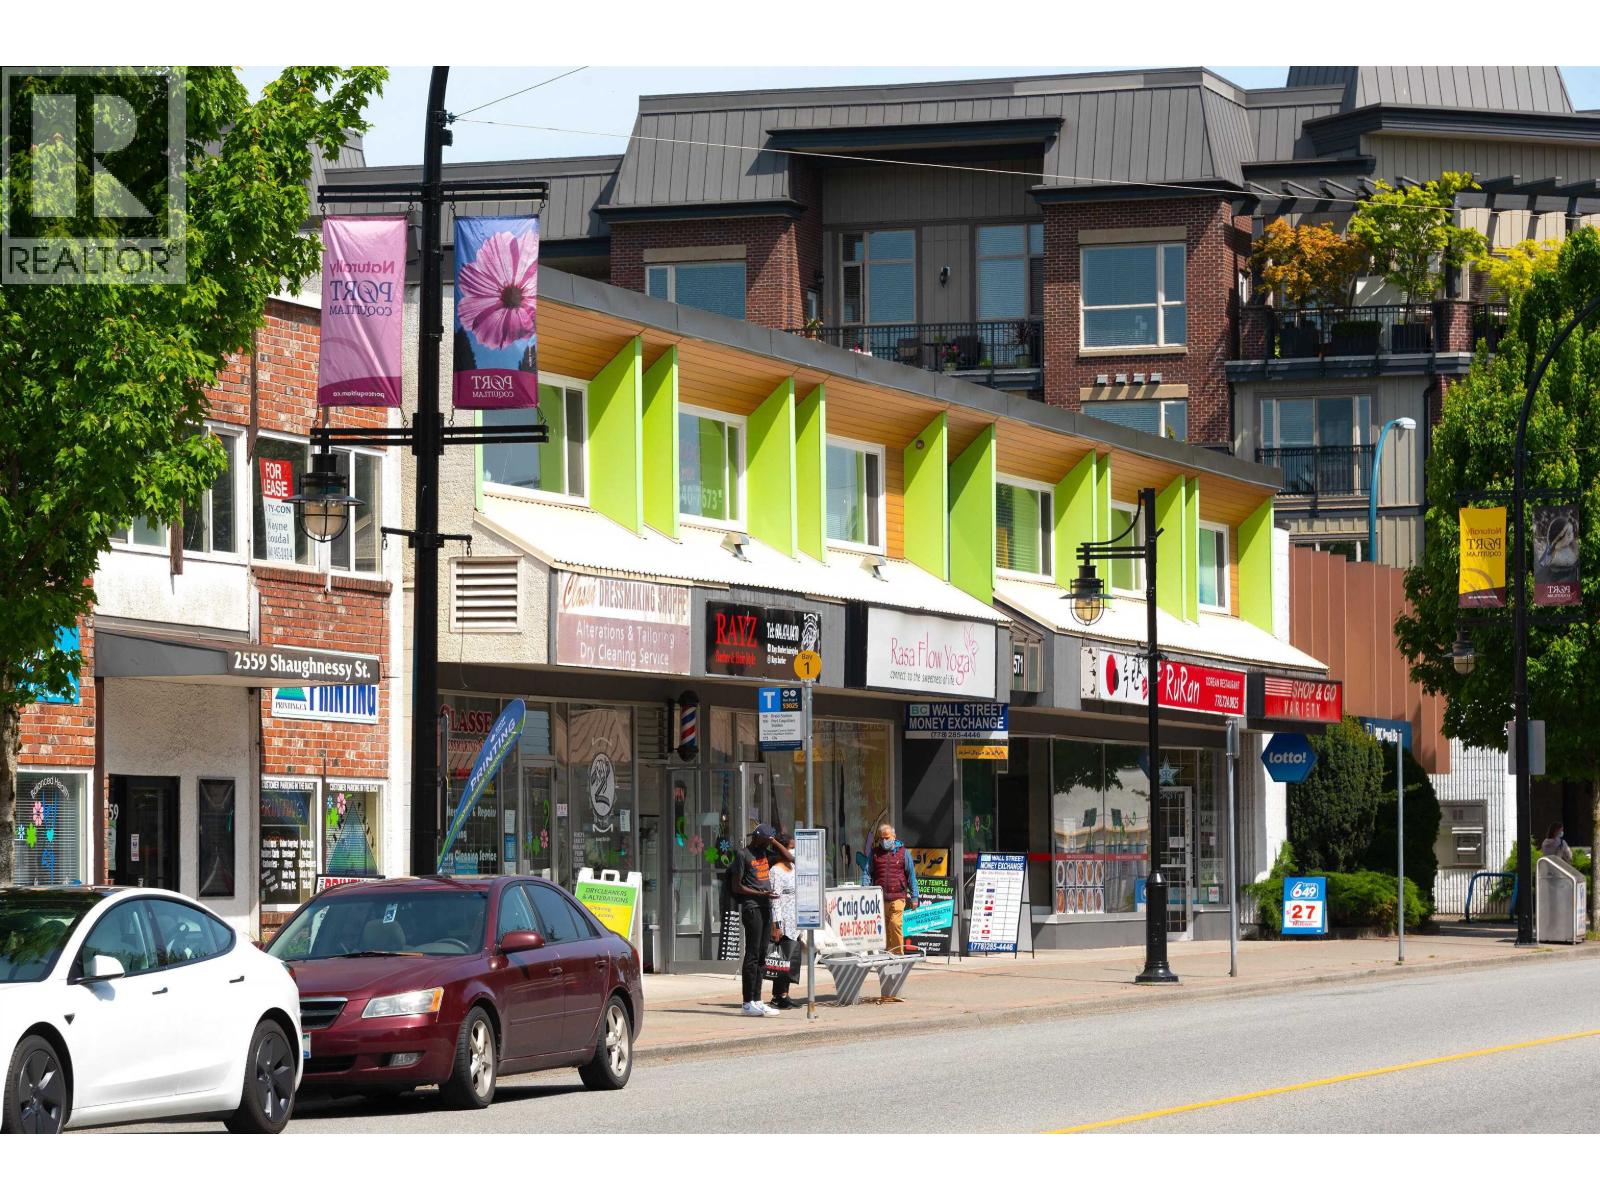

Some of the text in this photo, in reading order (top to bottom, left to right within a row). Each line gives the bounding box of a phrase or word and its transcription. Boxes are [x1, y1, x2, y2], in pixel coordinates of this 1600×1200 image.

[265, 462, 281, 479] FOR
[263, 479, 289, 497] LEASE
[599, 580, 656, 612] DRESSMAKING
[658, 586, 689, 616] SHOPPE
[576, 620, 675, 649] Alterations & Tailoring
[580, 642, 669, 667] Dry Cleaning Service
[890, 631, 971, 686] Rasa Flow Yoga
[234, 651, 371, 681] 2559 Shaughnessy St.
[804, 662, 810, 675] 1
[890, 670, 907, 680] connect
[913, 671, 921, 682] the
[1165, 664, 1200, 705] RuRan
[1292, 681, 1337, 701] SHOP & GO
[932, 704, 960, 716] WALL
[963, 704, 1004, 716] STREET
[1284, 700, 1321, 718] VARIETY
[909, 717, 1004, 729] MONEY EXCHANGE
[470, 718, 516, 792] PRINTING
[1269, 751, 1307, 764] lotto!
[31, 775, 54, 799] Balanced
[454, 851, 478, 866] Cleaning
[479, 851, 497, 862] Service
[998, 862, 1024, 870] EXCHANGE
[588, 894, 628, 904] ALTERATIONS
[930, 886, 954, 894] THERAPY
[837, 894, 858, 920] Craig
[860, 893, 881, 915] Cook
[1291, 904, 1316, 920] 27
